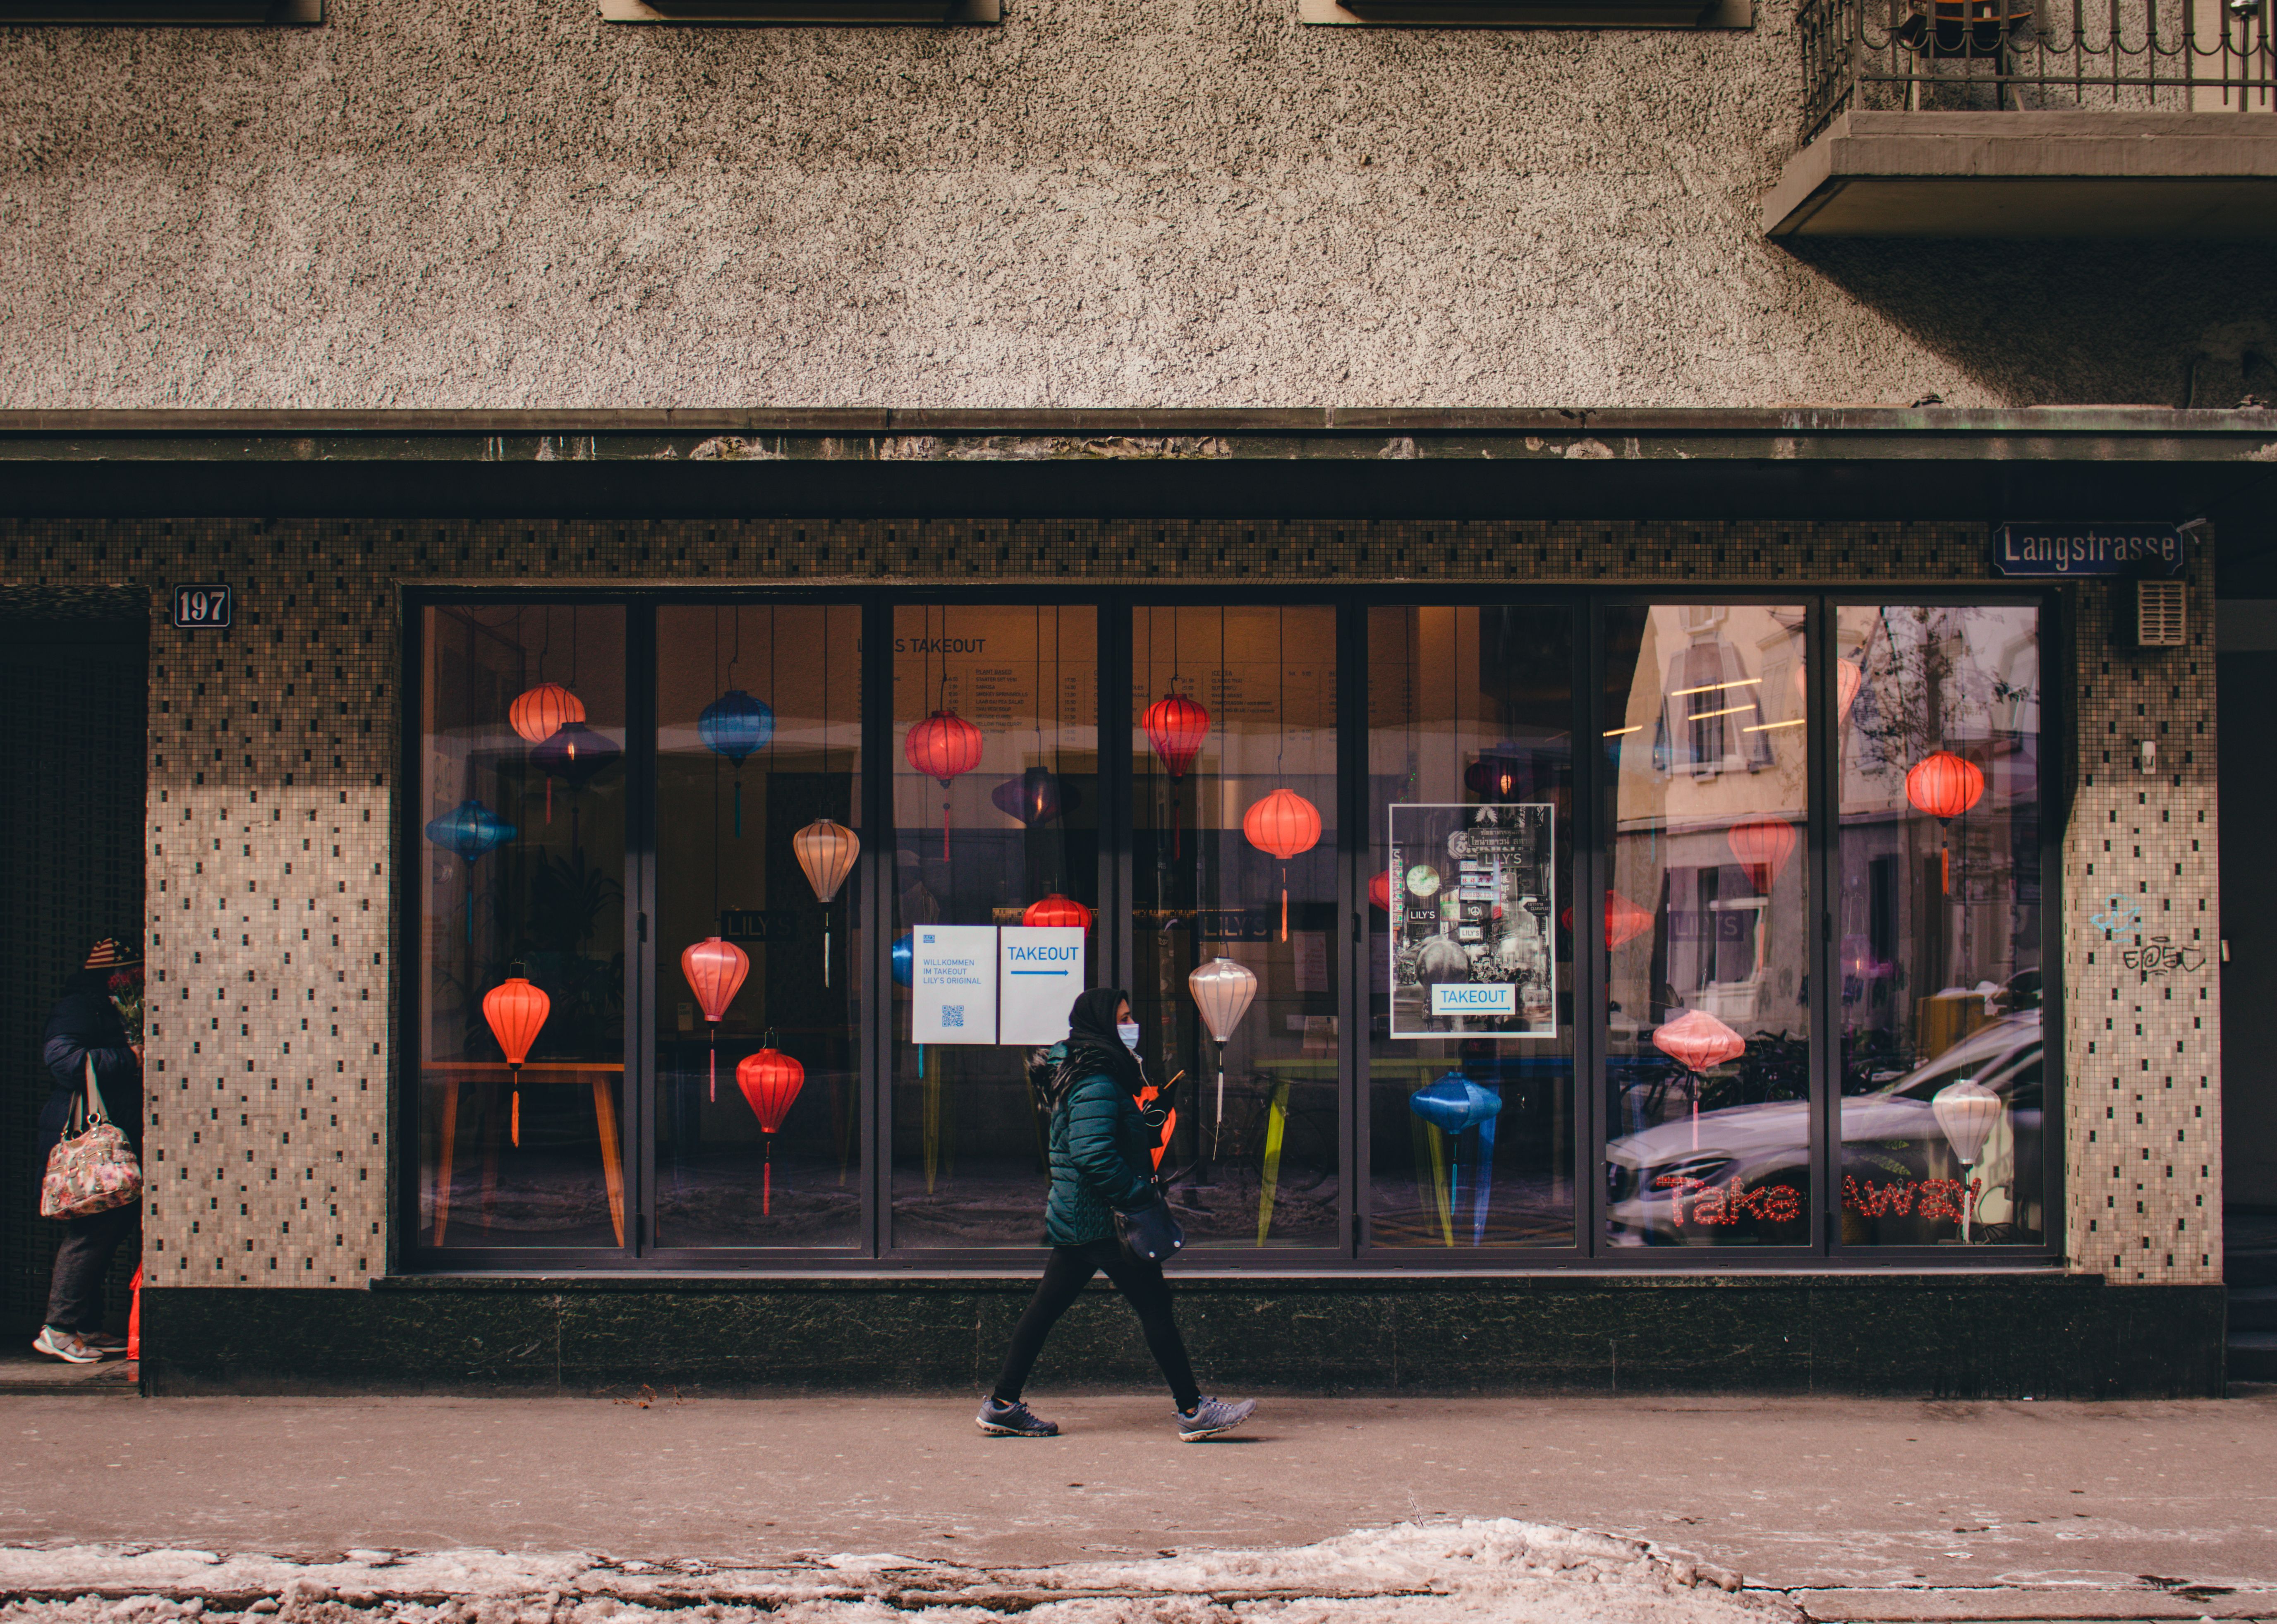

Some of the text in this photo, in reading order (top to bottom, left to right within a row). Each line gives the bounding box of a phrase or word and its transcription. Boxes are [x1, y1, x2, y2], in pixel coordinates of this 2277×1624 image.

[2005, 527, 2174, 571] Langstrasse
[180, 592, 225, 620] 197
[910, 639, 986, 652] TAKEOUT
[1485, 853, 1522, 864] LILY'S
[728, 916, 790, 936] LILY'S
[1204, 916, 1267, 936] LILY'S
[1007, 947, 1079, 960] TAKEOUT
[1441, 990, 1506, 1003] TAKEOUT
[1656, 1175, 1801, 1227] Take
